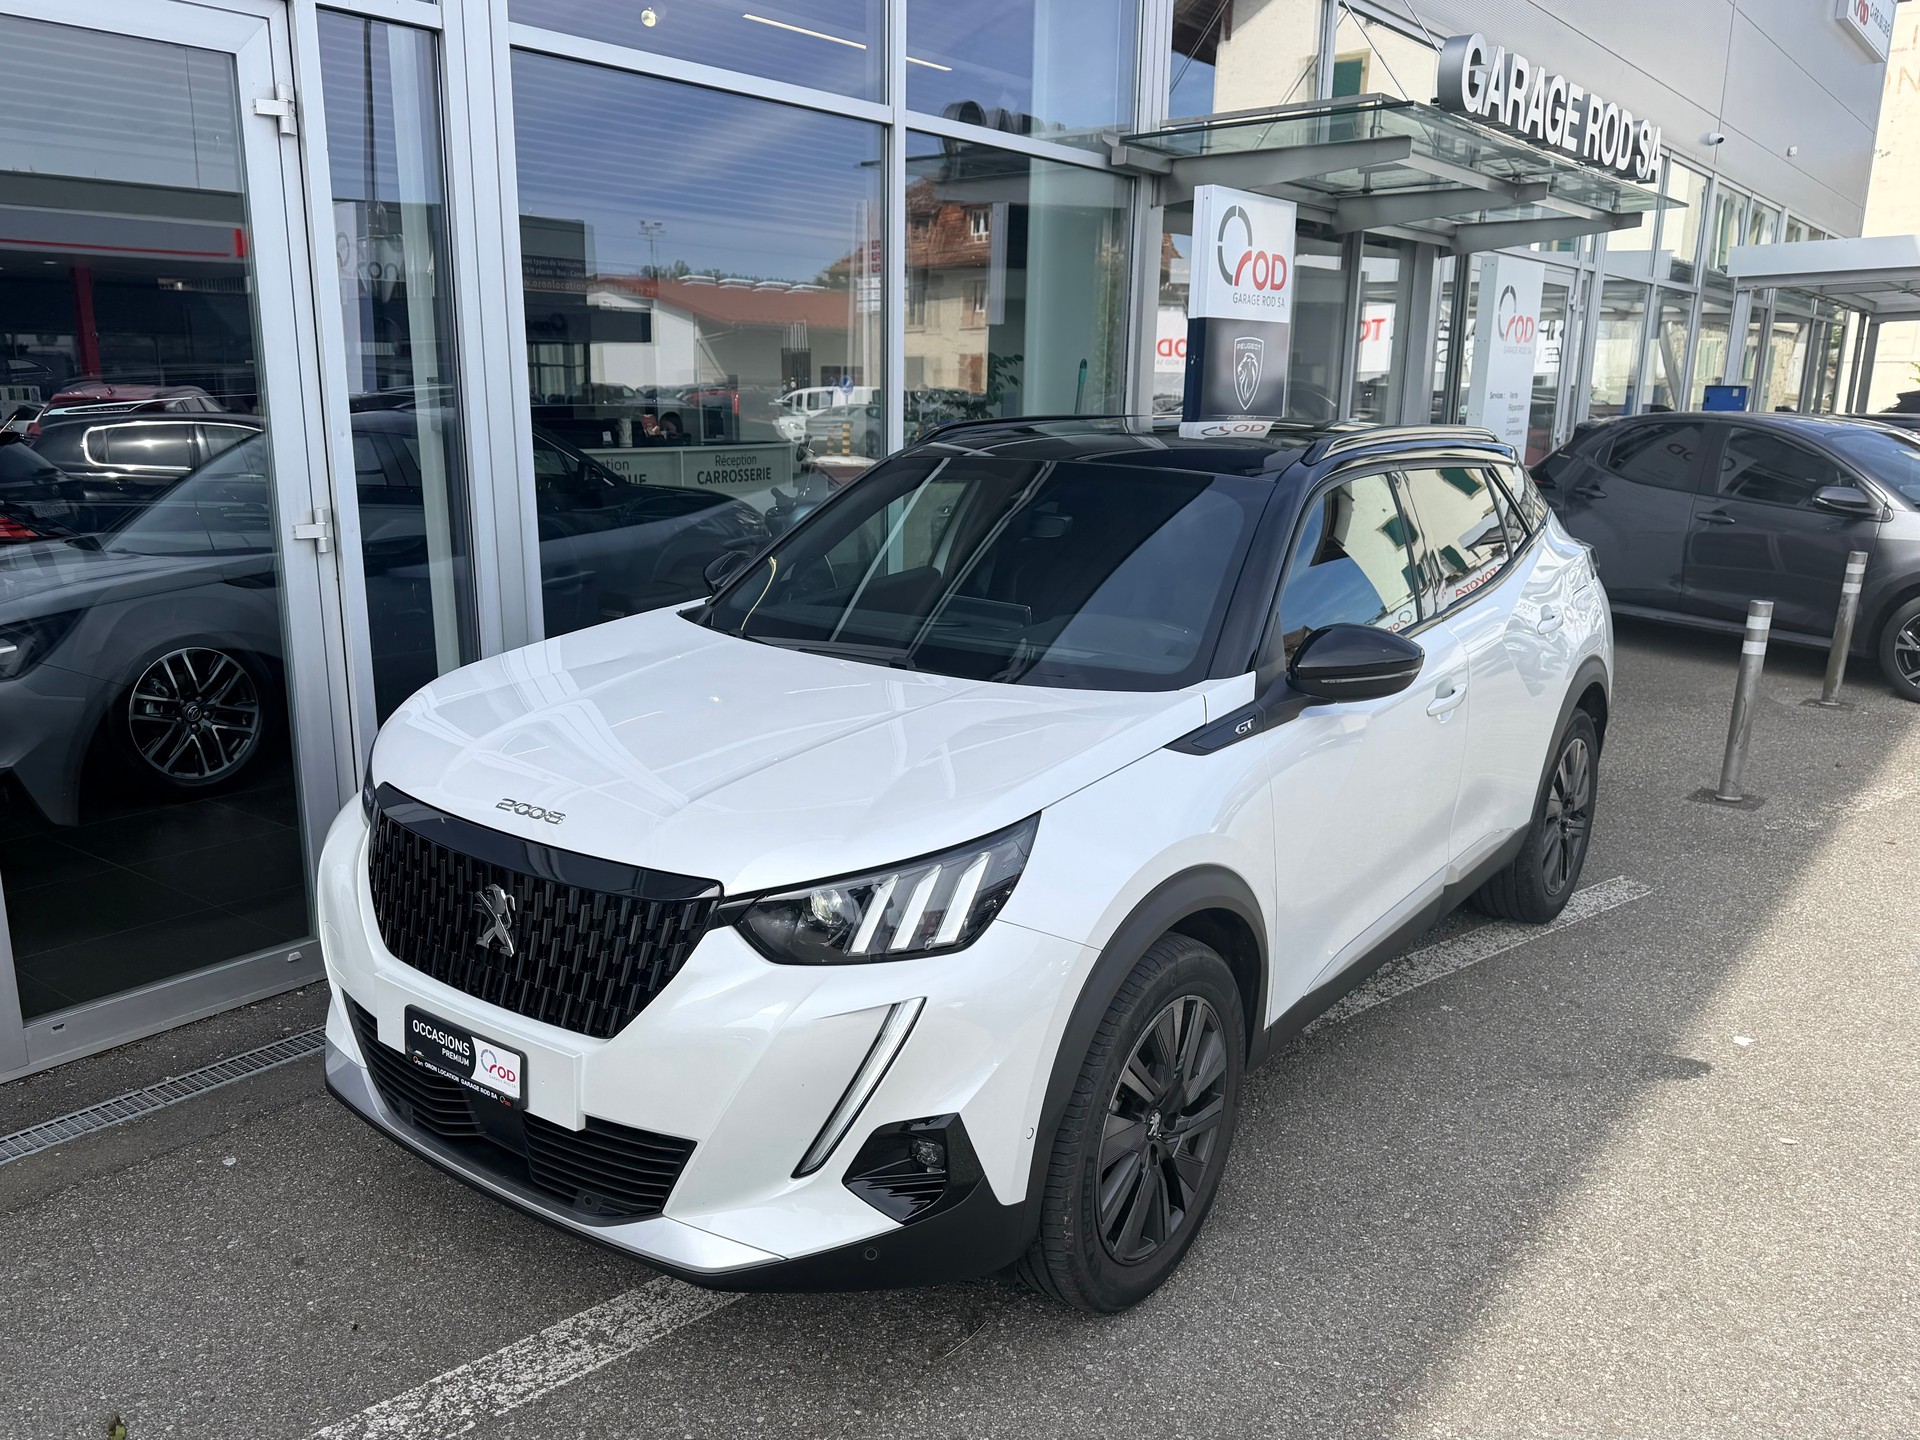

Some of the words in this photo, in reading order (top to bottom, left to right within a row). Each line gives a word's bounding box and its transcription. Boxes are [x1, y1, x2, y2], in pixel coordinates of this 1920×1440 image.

[1459, 32, 1584, 152] GARAGE
[1583, 93, 1634, 171] ROD
[1636, 118, 1662, 183] SA
[1232, 292, 1260, 306] GARAGE
[1262, 295, 1275, 308] ROD
[1277, 297, 1285, 308] SA
[1236, 342, 1261, 351] PEUGEOT
[715, 454, 757, 468] Réception
[696, 467, 772, 485] CARROSSERIE
[1234, 718, 1254, 735] GT
[495, 798, 567, 825] 2008
[412, 1019, 470, 1056] OCCASIONS
[441, 1048, 469, 1067] PREMIUM
[437, 1066, 460, 1083] LOCATION
[460, 1078, 480, 1092] GARAGE
[480, 1085, 490, 1097] ROD
[490, 1091, 498, 1100] SA
